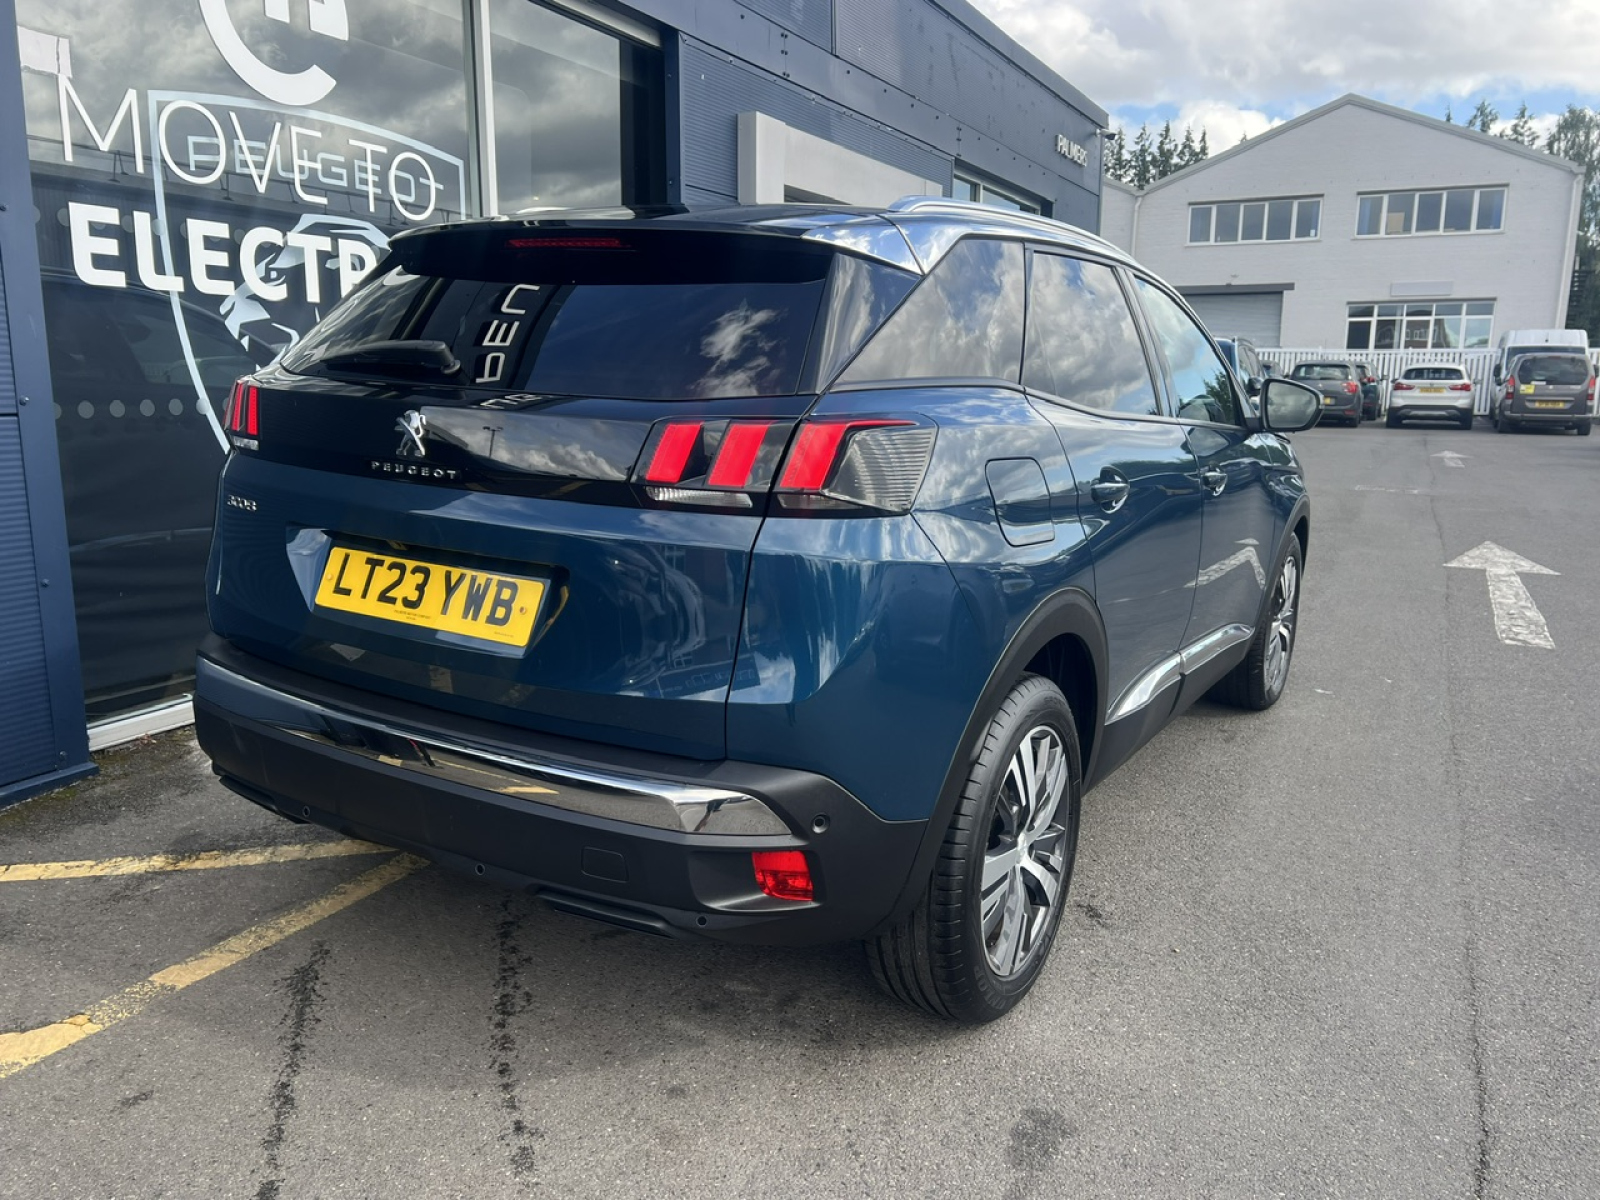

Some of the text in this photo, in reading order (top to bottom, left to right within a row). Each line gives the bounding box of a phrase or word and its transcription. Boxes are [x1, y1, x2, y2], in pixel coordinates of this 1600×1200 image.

[58, 74, 436, 221] MOVE TO
[1056, 134, 1087, 167] PALMERS
[370, 460, 456, 480] PEUGEOT
[227, 494, 257, 511] 3008
[332, 553, 519, 627] LT23 YWB
